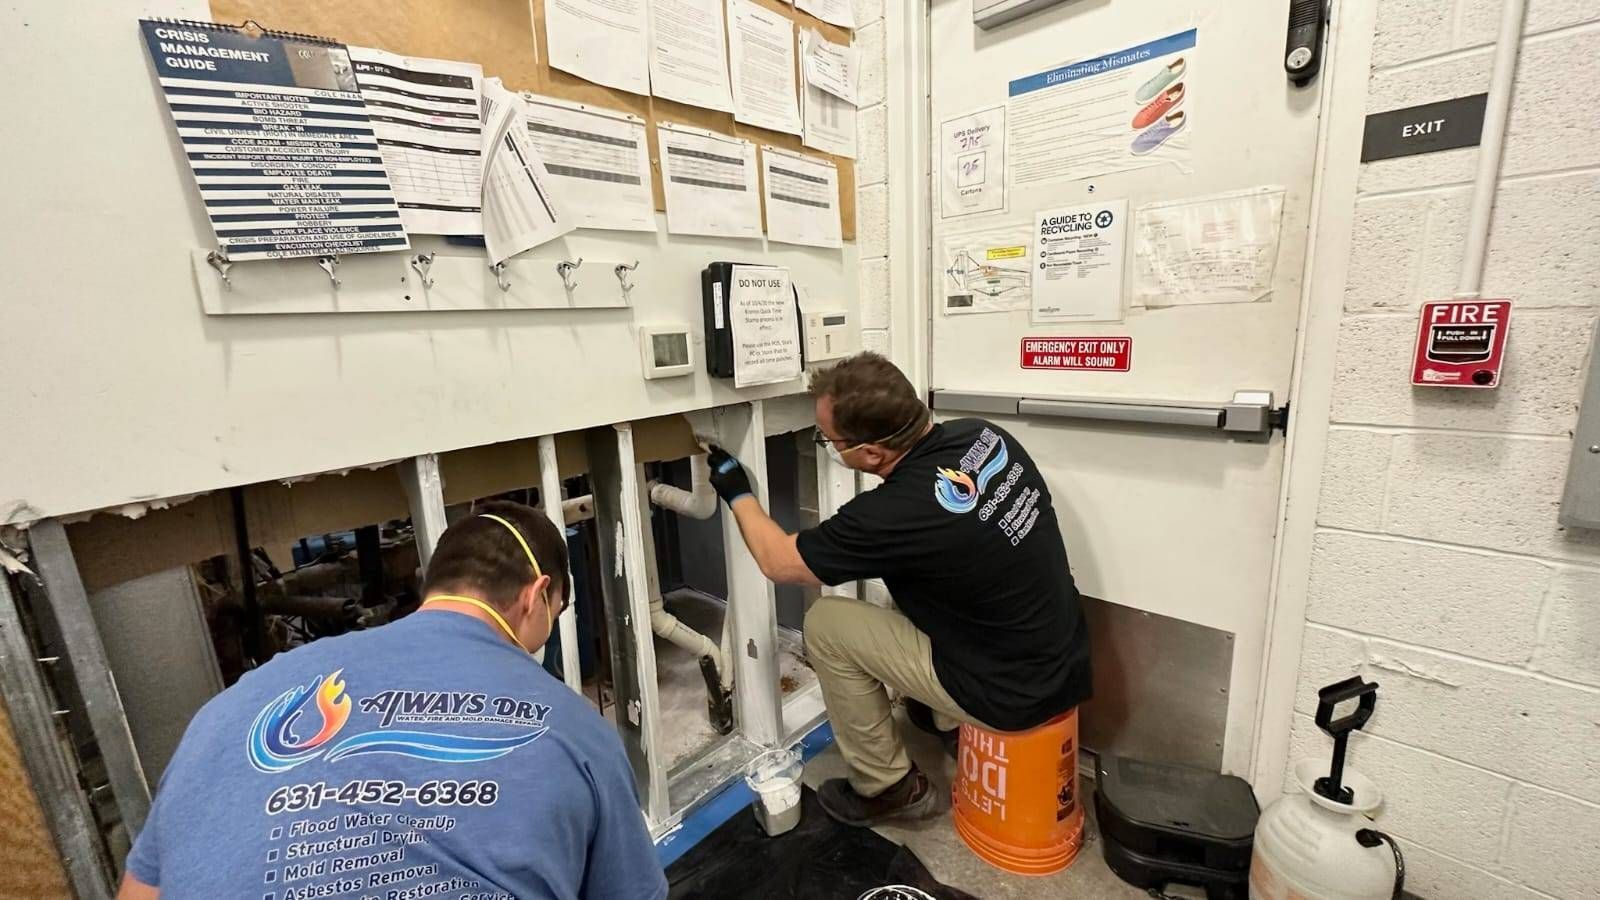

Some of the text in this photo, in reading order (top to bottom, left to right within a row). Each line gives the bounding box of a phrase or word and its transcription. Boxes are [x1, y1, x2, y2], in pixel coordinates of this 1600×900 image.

[155, 28, 209, 44] CRISIS
[160, 42, 270, 64] MANAGEMENT
[166, 57, 218, 72] GUIDE
[1046, 49, 1151, 84] Eliminating Mismates
[235, 92, 281, 101] IMPORTANT
[272, 102, 309, 110] SHOOTER
[954, 125, 991, 138] UPS Delivery
[1402, 119, 1445, 138] EXIT
[326, 148, 350, 156] INJURY
[302, 162, 337, 170] CONDUCT
[960, 188, 982, 196] Cartons
[1041, 212, 1092, 227] A GUIDE TO
[1041, 222, 1092, 235] RECYCLING
[276, 240, 364, 250] EVACUATION CHECKLIST
[739, 280, 782, 288] DO NOT USE
[1431, 304, 1501, 323] FIRE
[1026, 342, 1125, 354] EMERGENCY EXIT ONLY
[1033, 356, 1116, 368] ALARM WILL SOUND
[492, 696, 552, 722] DRY
[514, 719, 542, 727] REPAIRS
[960, 722, 1009, 763] THIS
[962, 745, 1006, 800] DO
[266, 780, 498, 815] 631-452-6368
[961, 777, 1005, 821] LET'S
[290, 812, 455, 837] Flood Water CleanUp
[286, 830, 376, 860] Structural
[284, 848, 404, 882] Mold Removal
[284, 864, 438, 900] Asbestos Removal
[386, 878, 480, 900] Restoration
